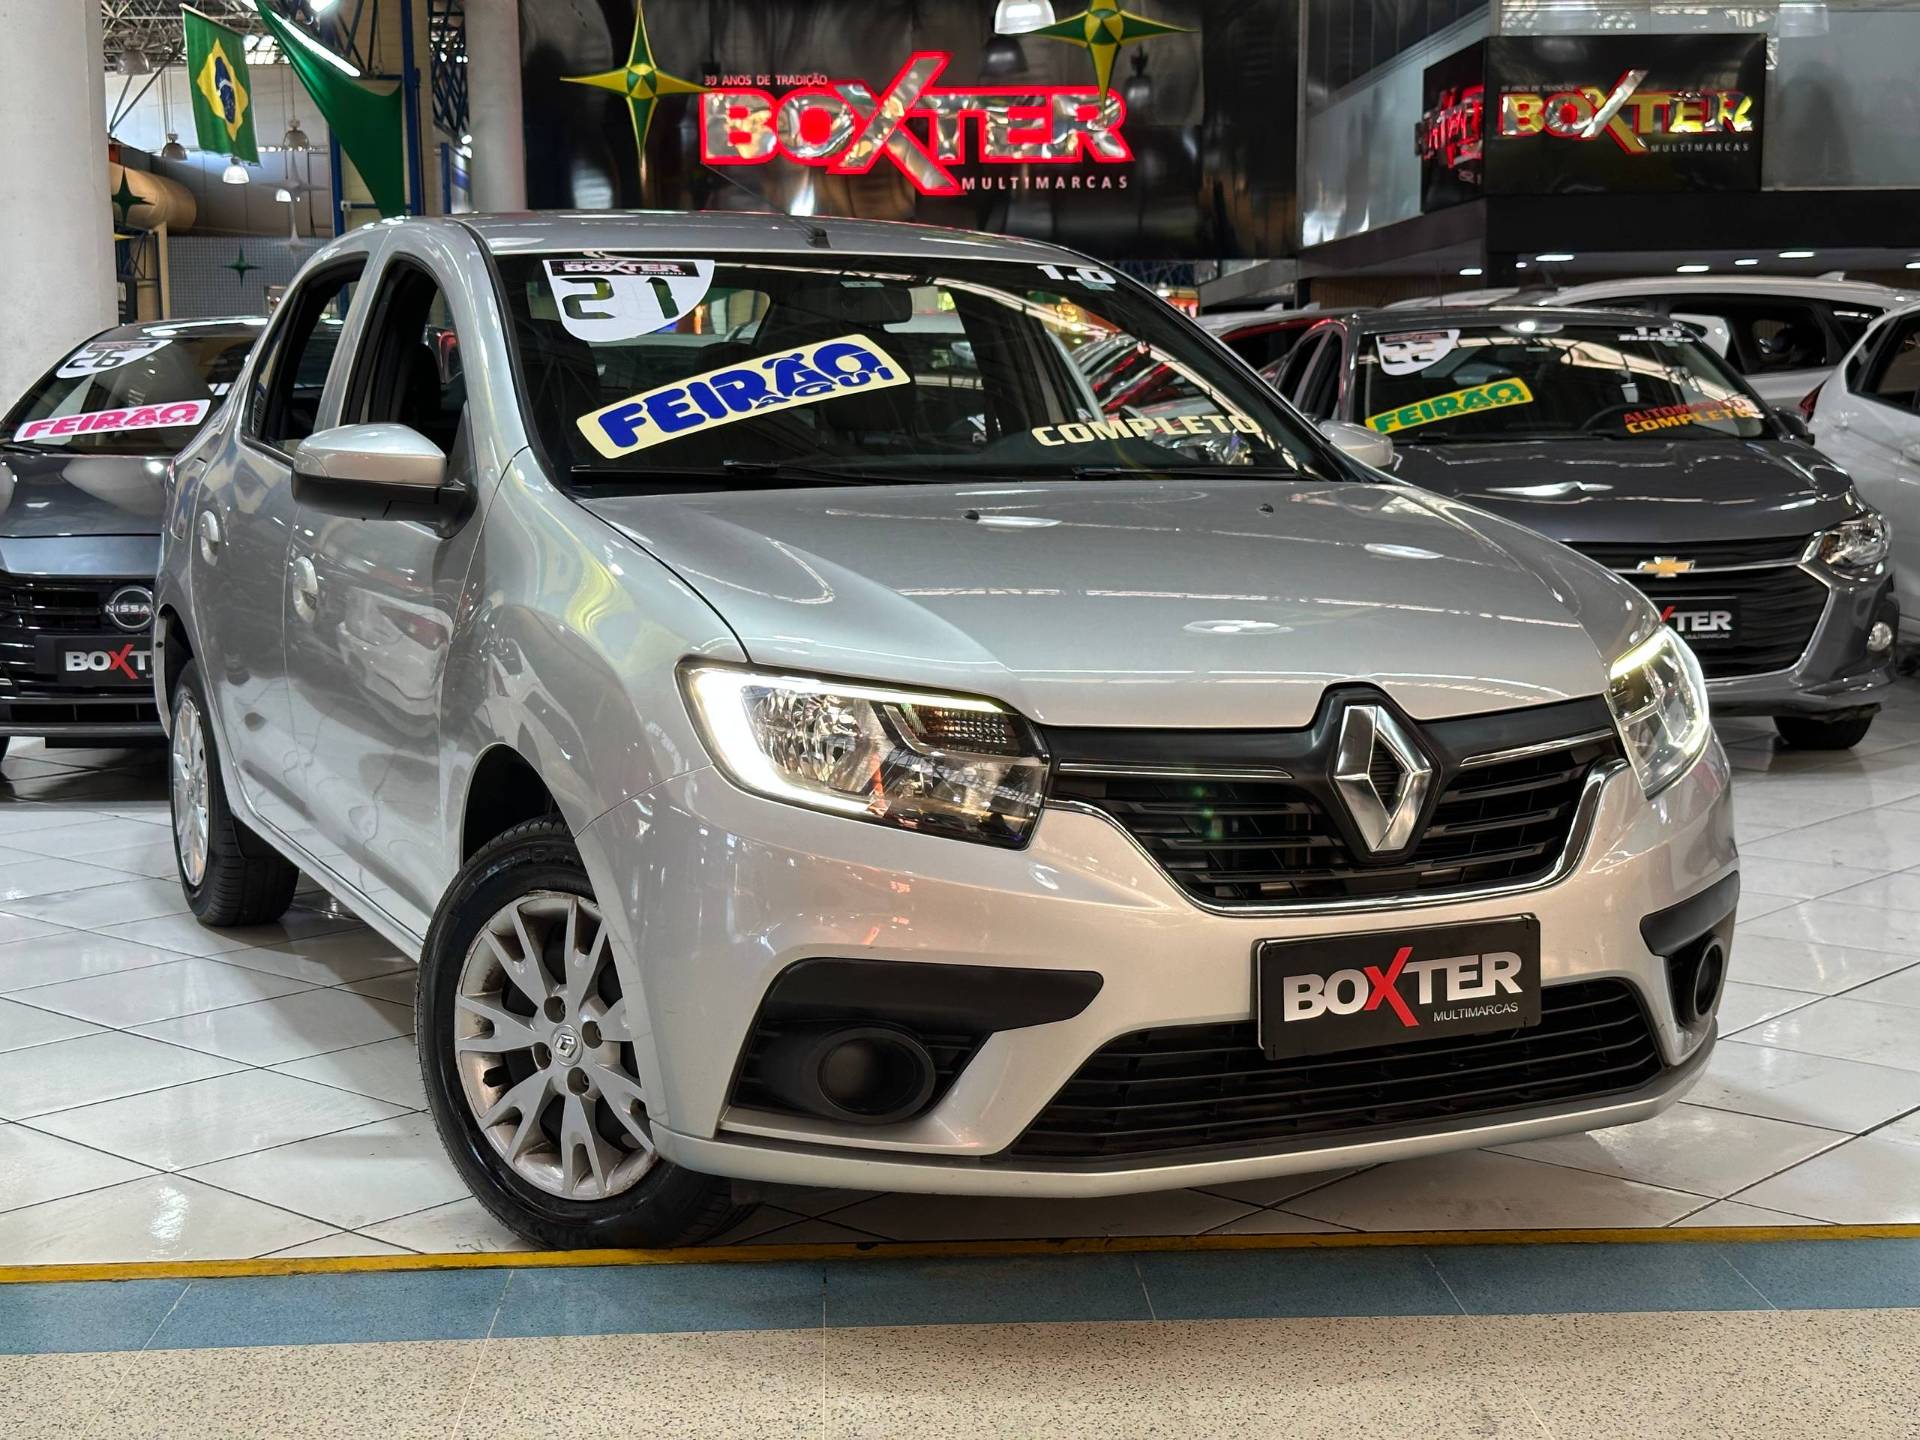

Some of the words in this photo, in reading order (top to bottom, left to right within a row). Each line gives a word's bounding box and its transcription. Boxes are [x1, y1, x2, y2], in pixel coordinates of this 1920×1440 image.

[721, 74, 752, 85] ANOS
[756, 75, 771, 85] DE
[775, 72, 828, 87] TRADIÇÃO
[699, 51, 1135, 195] BOXTER
[1498, 69, 1752, 155] BOXTER
[1649, 143, 1750, 153] MULTIMARCAS
[961, 175, 1128, 190] MULTIMARCAS
[563, 260, 682, 275] BOXTER
[1037, 264, 1117, 285] 1.0
[559, 276, 680, 319] 21
[598, 343, 884, 448] FEIRÃO
[1374, 383, 1522, 433] FEIRÃO
[23, 403, 200, 438] FEIRÃO
[1031, 414, 1262, 447] COMPLETO
[1626, 408, 1753, 434] COMPLETO
[105, 604, 150, 612] NISSA
[1661, 605, 1733, 632] TER
[65, 644, 153, 679] BOXT
[1283, 946, 1524, 1028] BOXTER
[1433, 1001, 1520, 1023] MULTIMARCAS
